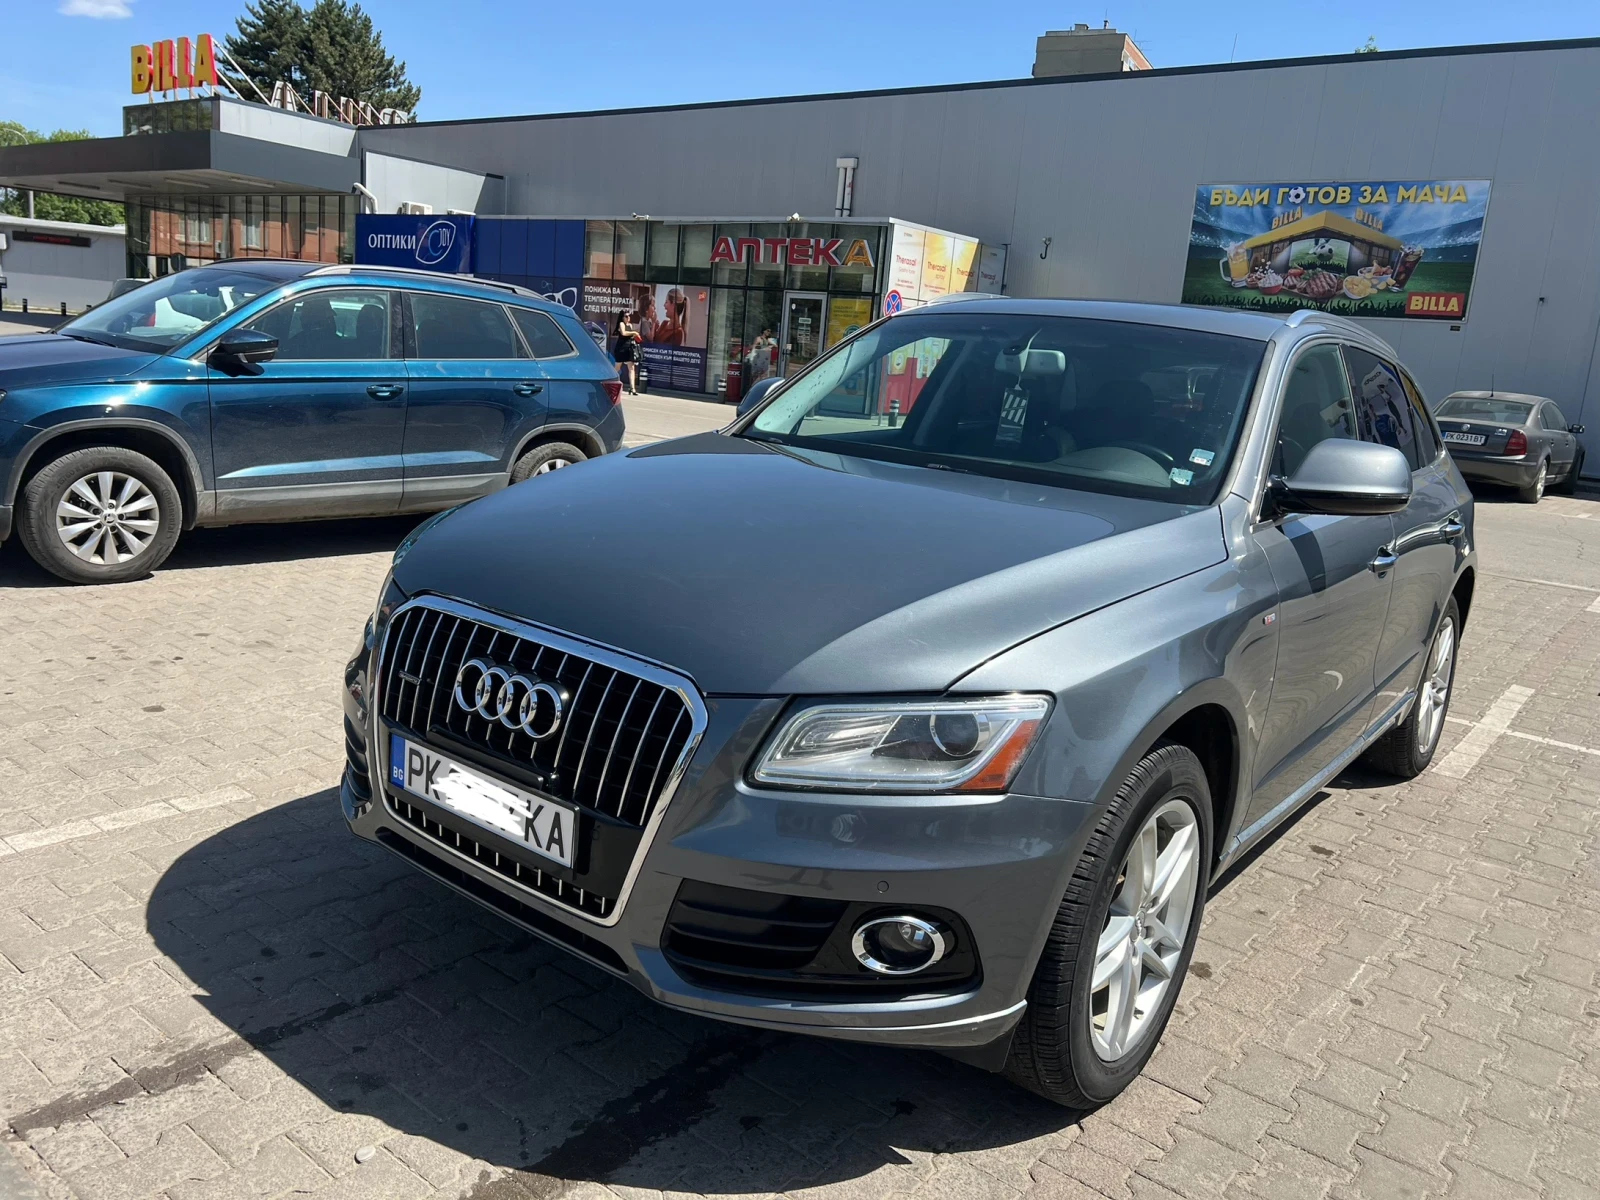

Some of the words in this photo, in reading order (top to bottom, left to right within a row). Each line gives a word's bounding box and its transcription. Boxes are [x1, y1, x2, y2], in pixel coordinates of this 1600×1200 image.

[130, 33, 218, 95] BILLA
[1210, 187, 1270, 206] БЪДИ
[1358, 185, 1389, 204] ЗА
[1397, 184, 1468, 203] МАЧА
[1271, 205, 1303, 230] BILLA
[1355, 206, 1384, 231] BILLA
[368, 233, 416, 250] ОПТИКИ
[709, 237, 875, 268] АПТЕКА
[584, 304, 600, 314] СЛЕД
[601, 305, 608, 313] 15
[1410, 295, 1459, 312] BILLA
[393, 765, 404, 781] BG
[407, 747, 442, 801] PK
